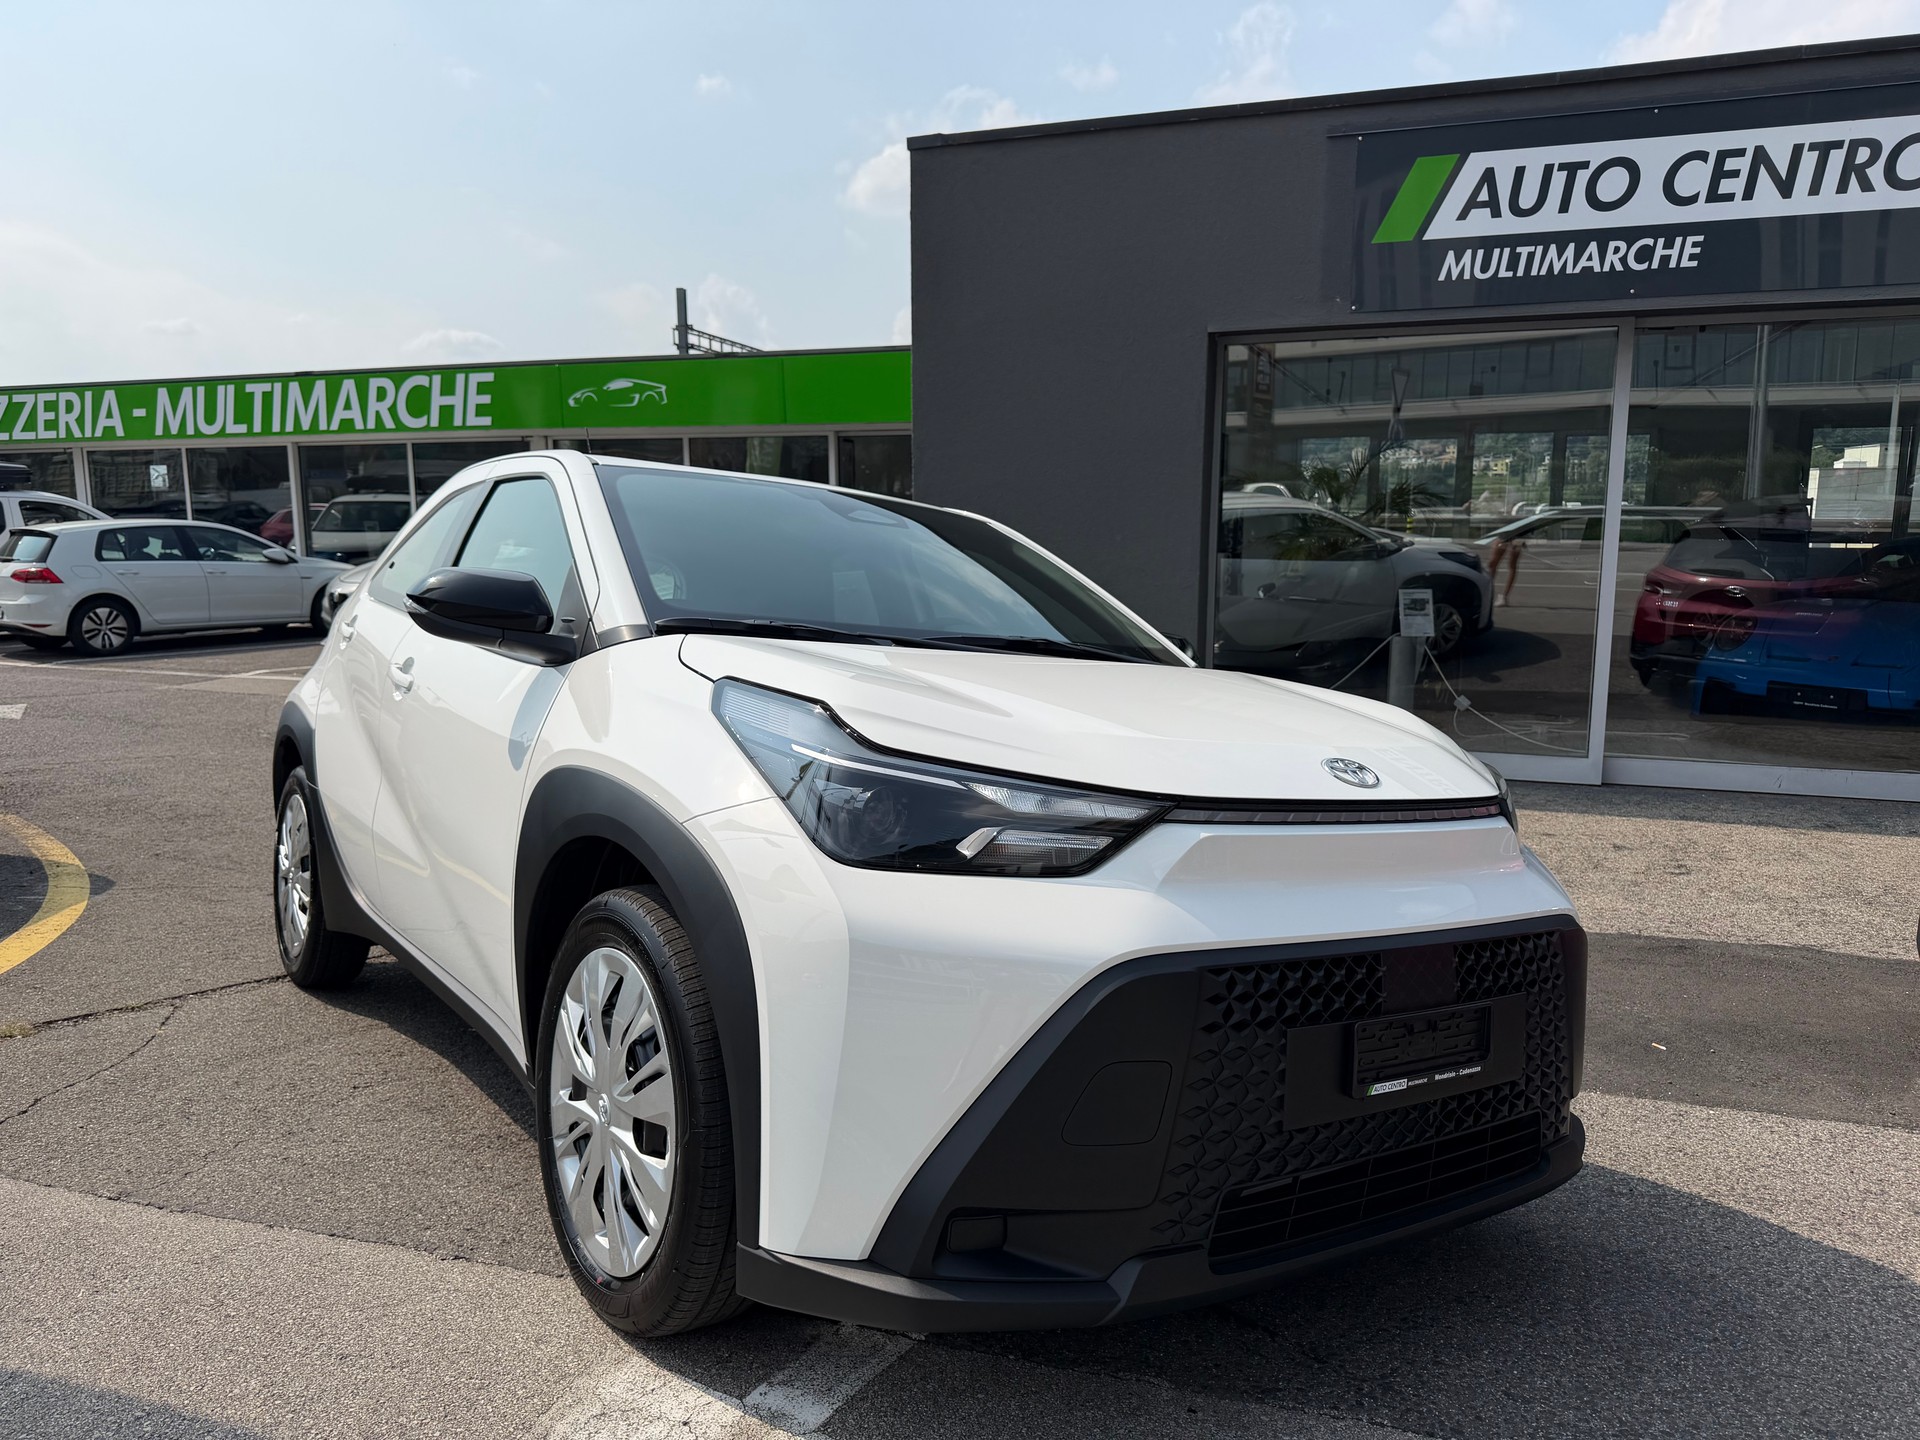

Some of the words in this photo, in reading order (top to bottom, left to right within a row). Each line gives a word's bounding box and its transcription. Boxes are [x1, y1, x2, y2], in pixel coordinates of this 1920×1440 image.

[1455, 156, 1641, 221] AUTO
[1438, 234, 1705, 282] MULTIMARCHE
[155, 372, 495, 436] MULTIMARCHE
[1373, 1084, 1387, 1093] AUTO
[1387, 1080, 1406, 1091] CENTRO
